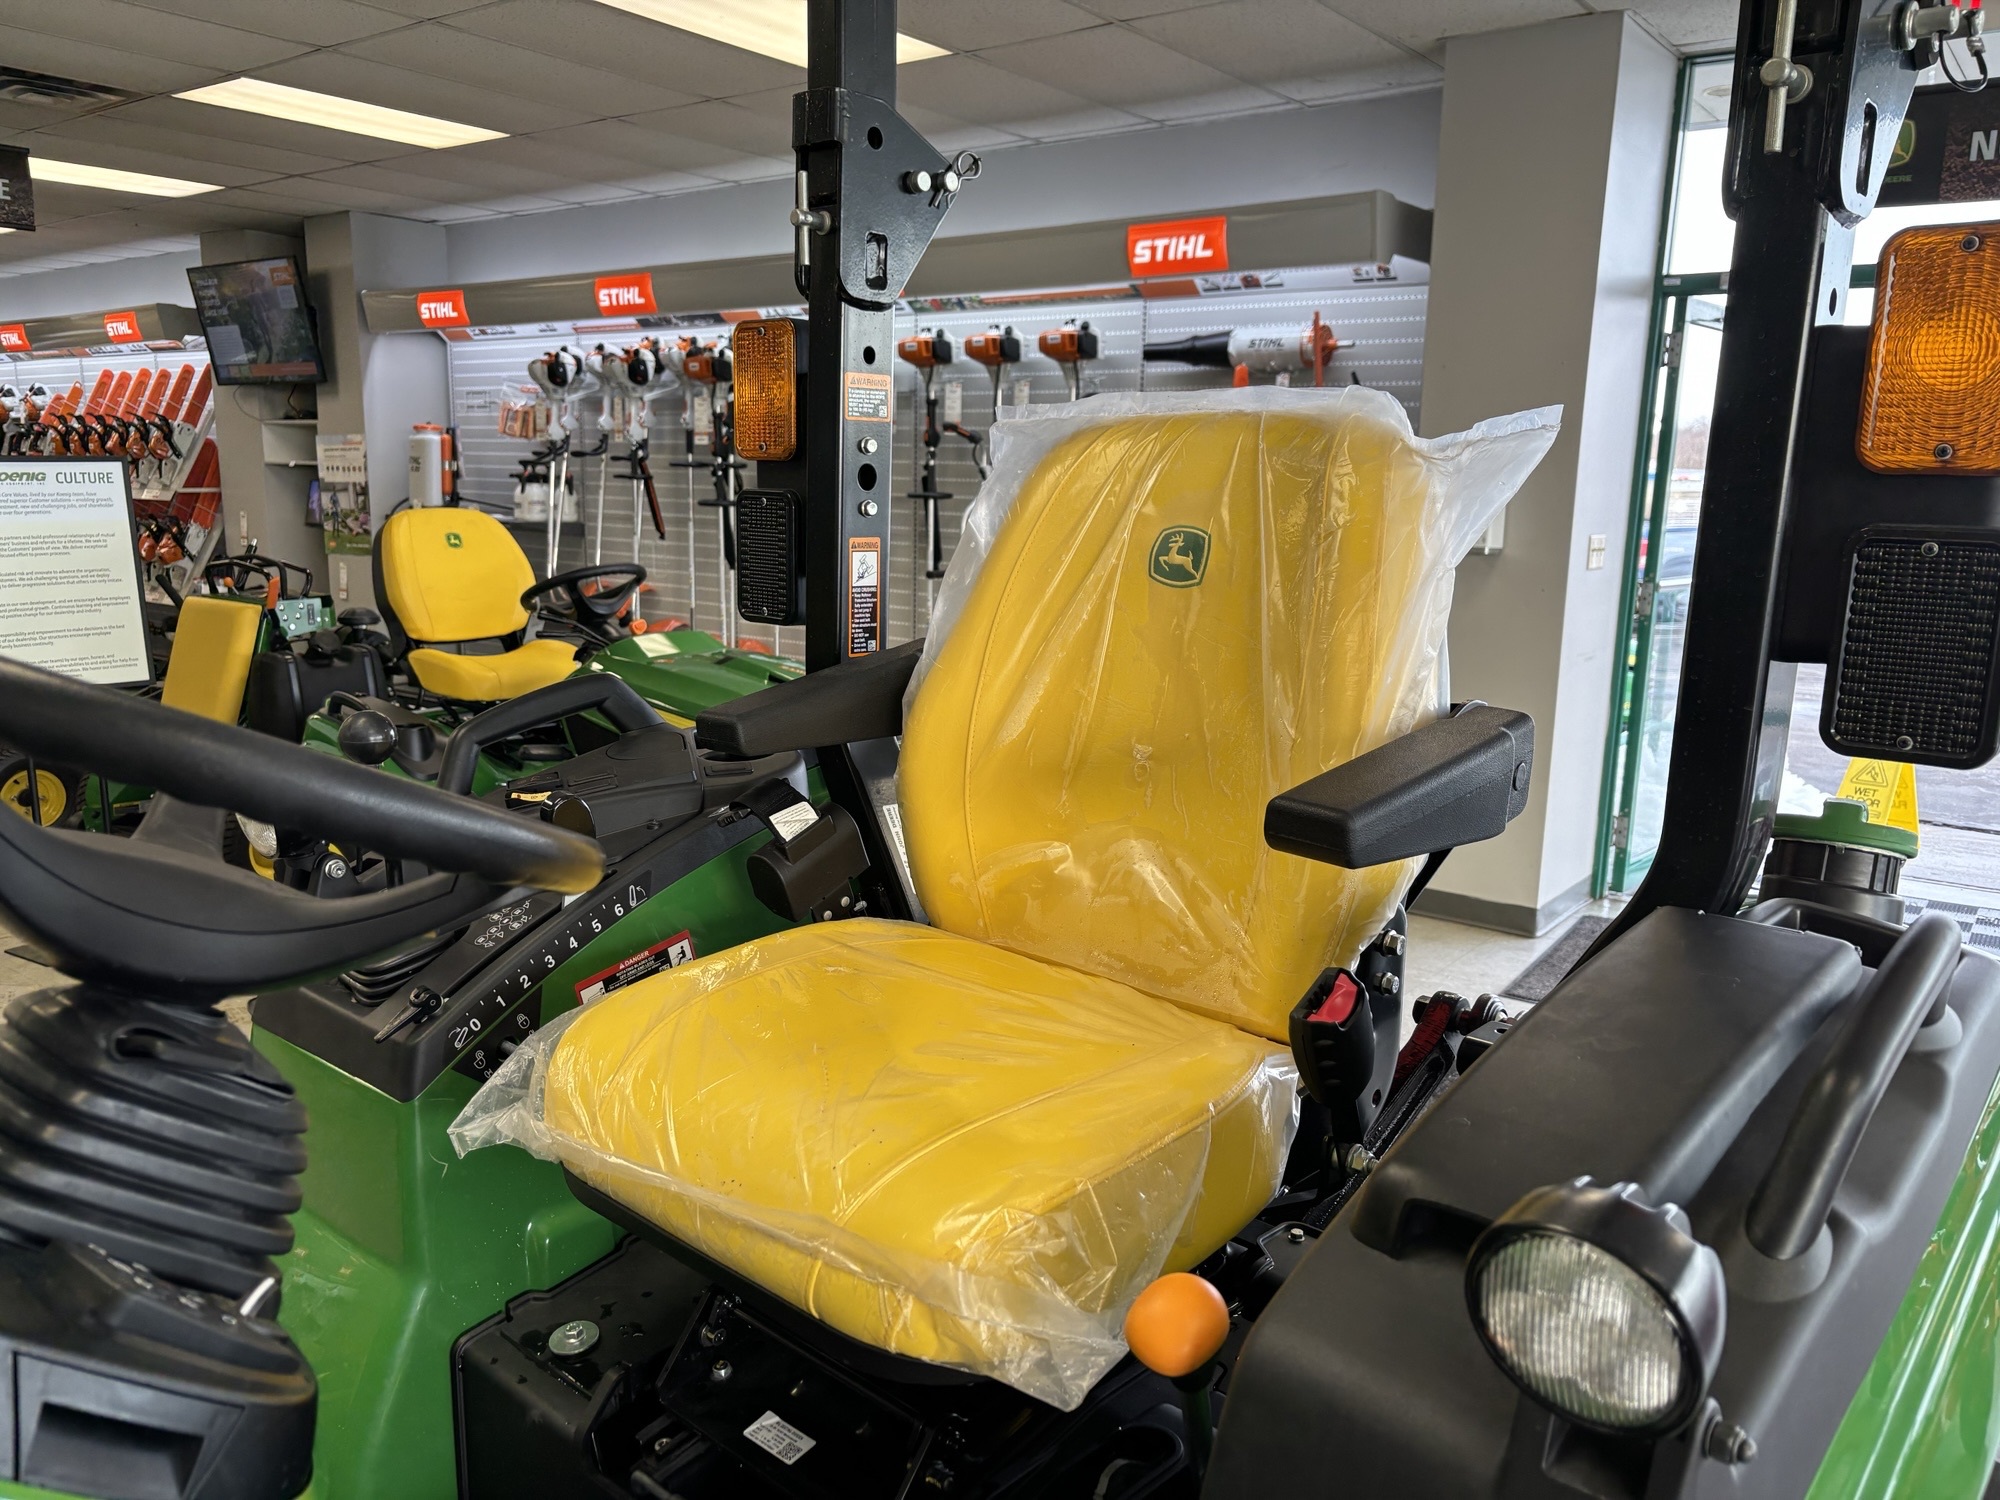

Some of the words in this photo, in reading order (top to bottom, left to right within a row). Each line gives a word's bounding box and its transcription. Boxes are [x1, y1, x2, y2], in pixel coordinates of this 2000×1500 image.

[1969, 130, 2000, 161] N
[1884, 175, 1912, 183] EERE
[1133, 234, 1213, 263] STIHL
[599, 286, 645, 306] STIHL
[421, 302, 458, 319] STIHL
[106, 320, 133, 337] STIHL
[1, 332, 22, 345] STIHL
[1248, 337, 1286, 349] STIHL
[856, 377, 888, 387] WARNING
[56, 472, 114, 484] CULTURE
[1854, 786, 1880, 798] WET
[886, 808, 897, 828] DEERE
[895, 831, 904, 848] JOHN
[624, 951, 649, 966] DANGER
[470, 1018, 482, 1032] 0
[496, 995, 507, 1007] 1
[520, 974, 532, 988] 2
[544, 955, 556, 968] 3
[568, 936, 578, 950] 4
[592, 919, 602, 932] 5
[614, 904, 624, 916] 6
